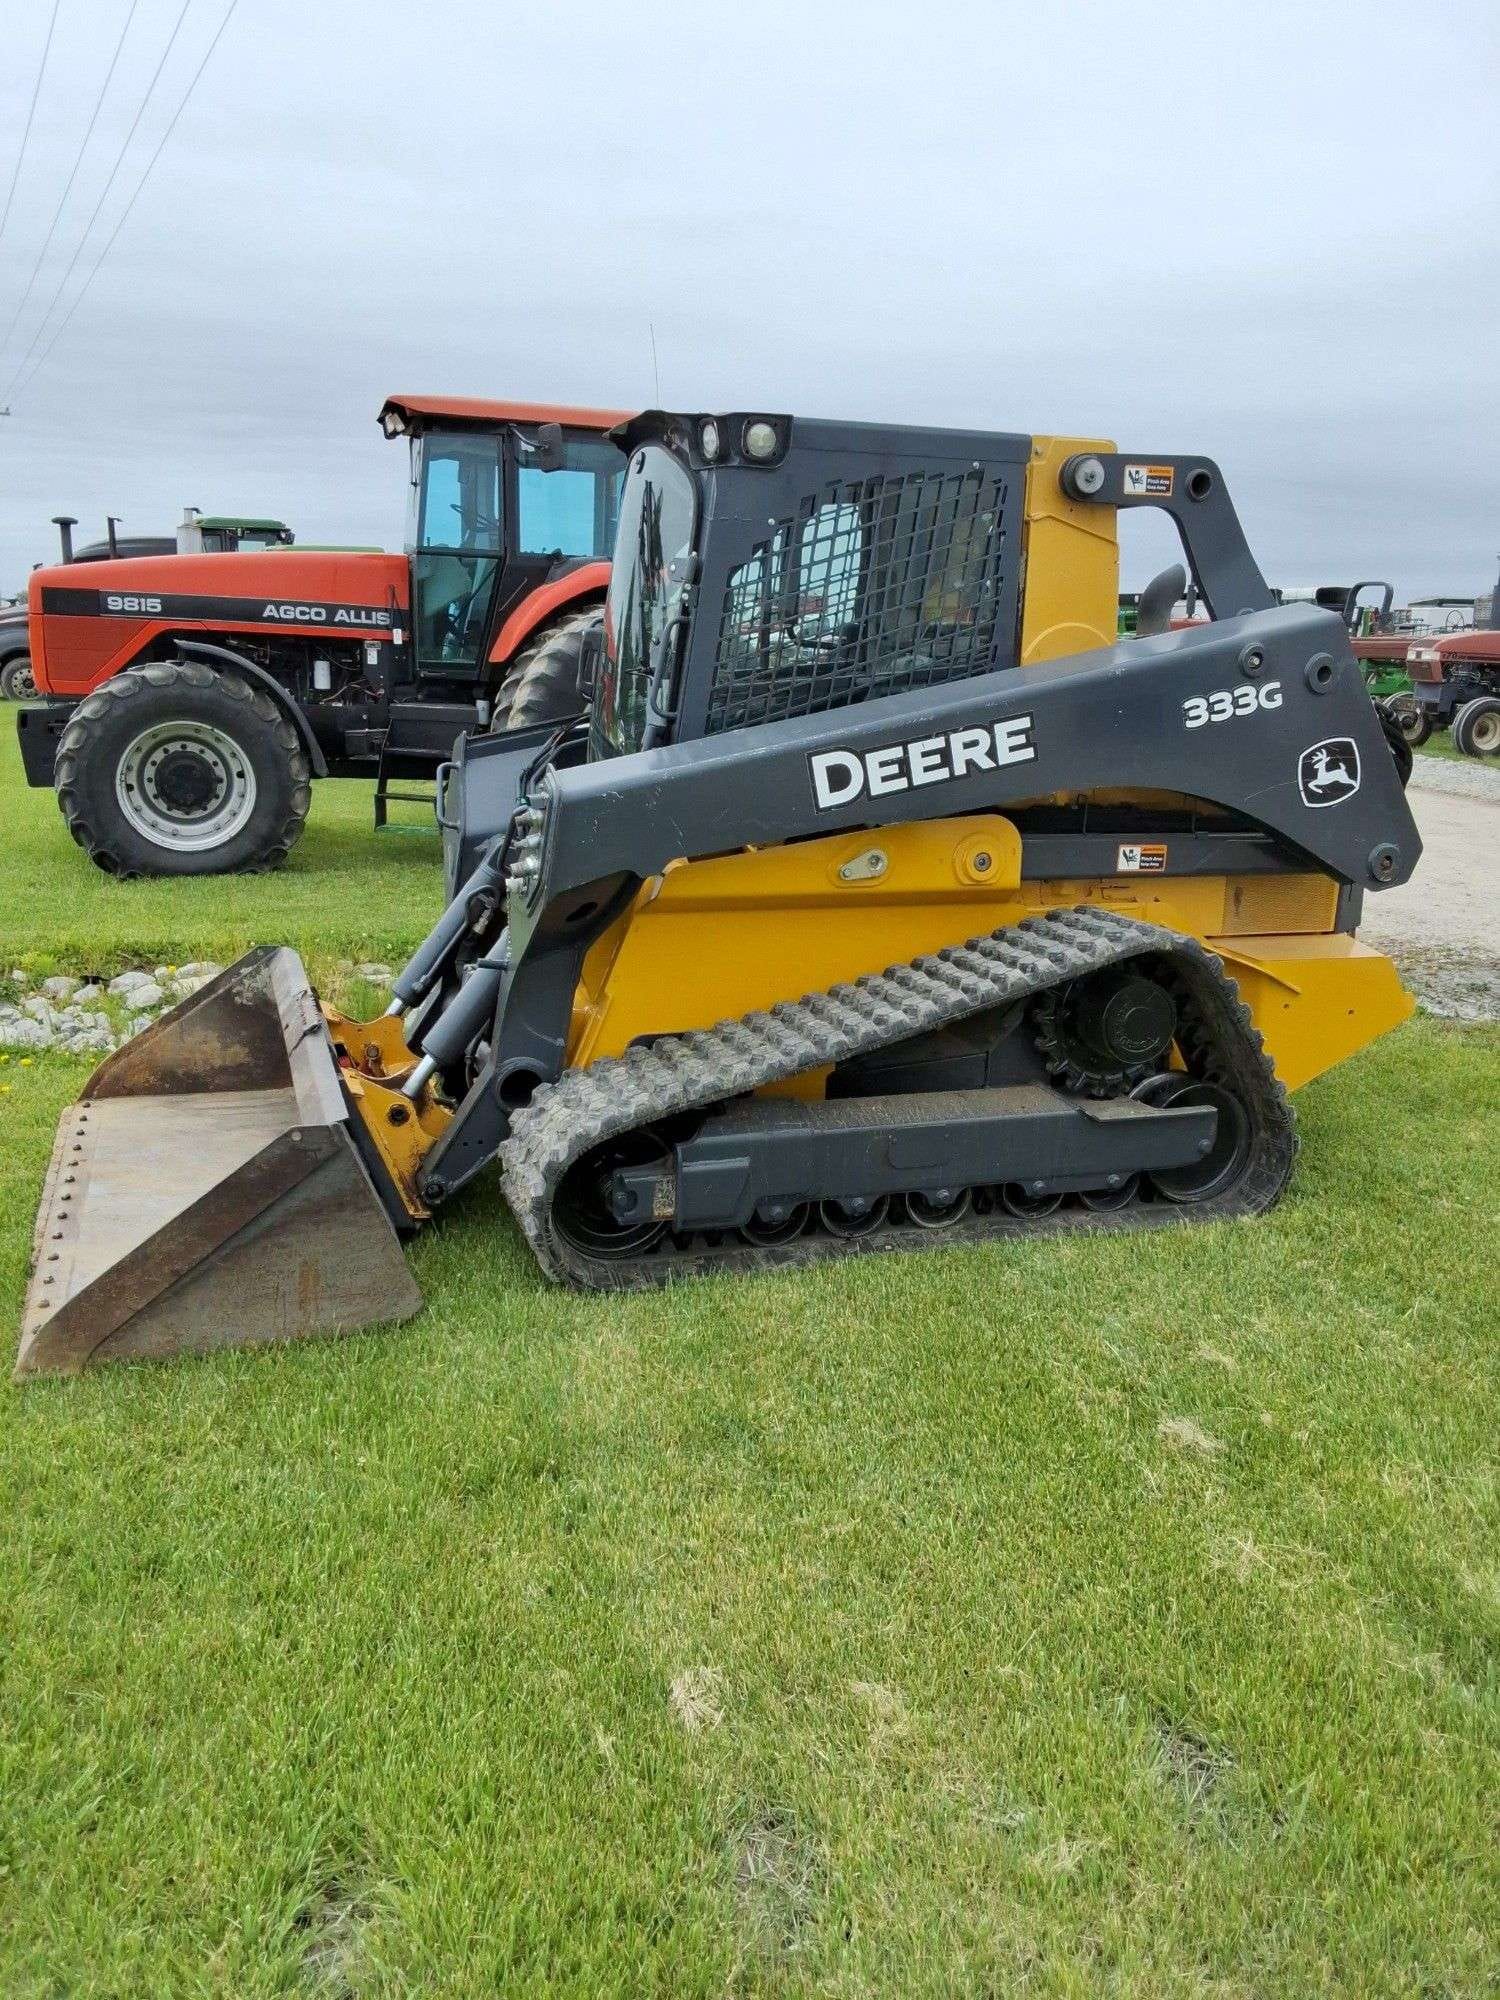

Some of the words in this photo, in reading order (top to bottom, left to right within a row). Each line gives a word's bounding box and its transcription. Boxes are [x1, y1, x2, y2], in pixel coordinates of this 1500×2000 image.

[107, 596, 162, 612] 9815
[262, 604, 327, 621] AGCO
[334, 609, 391, 625] ALLIS
[1183, 681, 1283, 728] 333G
[811, 716, 1035, 809] DEERE
